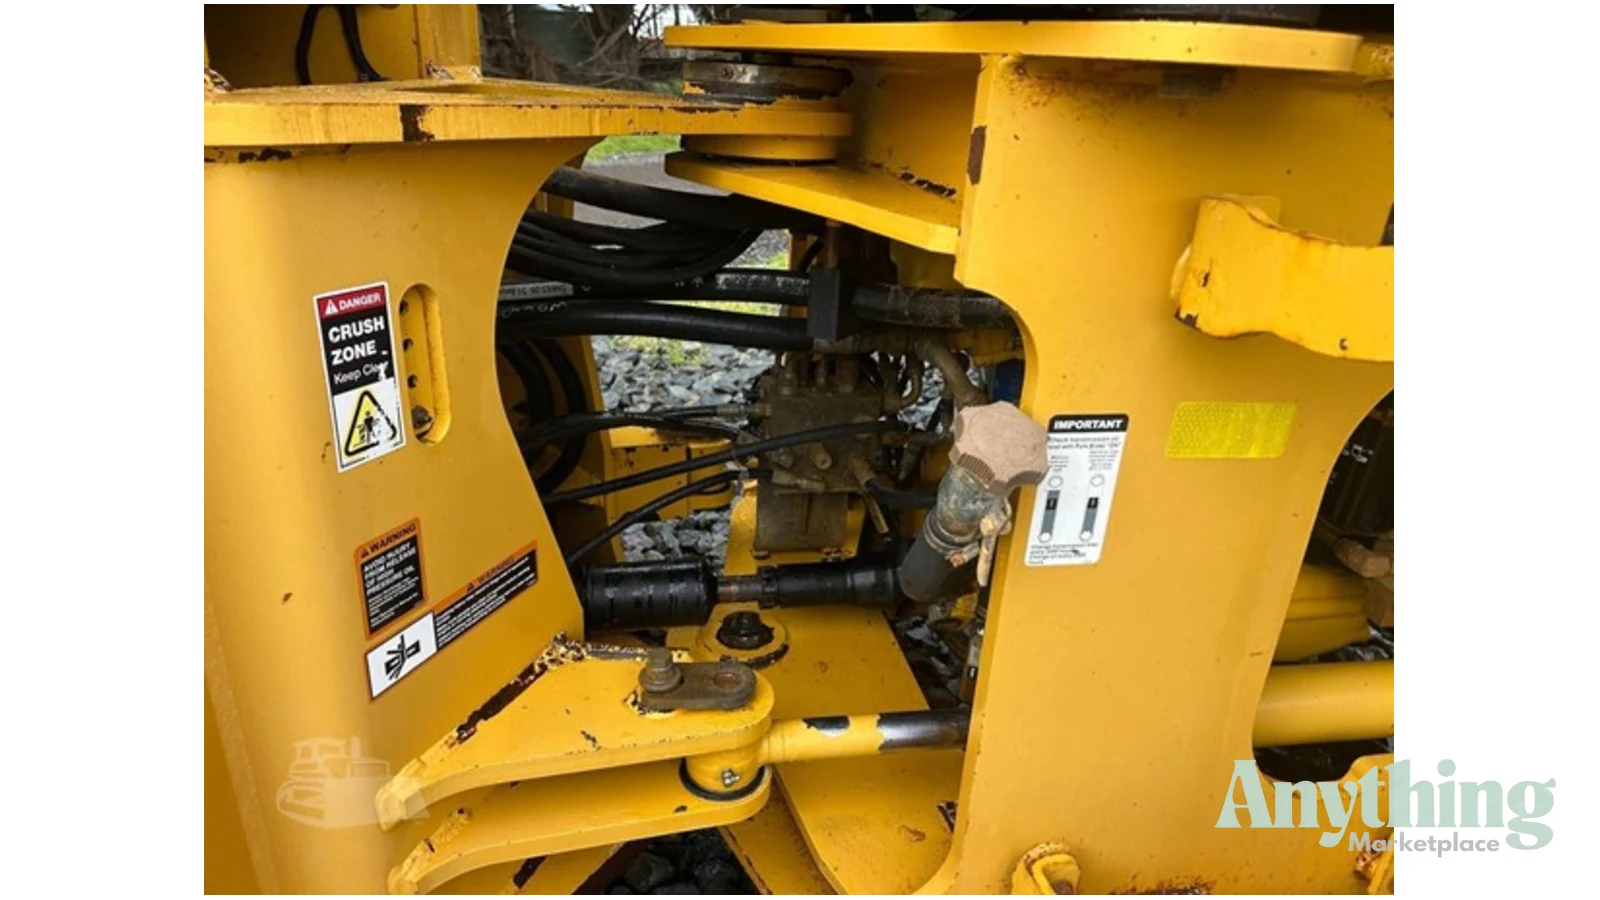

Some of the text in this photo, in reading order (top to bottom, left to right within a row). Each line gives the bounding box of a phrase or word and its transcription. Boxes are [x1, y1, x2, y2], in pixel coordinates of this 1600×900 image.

[339, 292, 381, 310] DANGER
[328, 316, 385, 343] CRUSH
[331, 341, 377, 366] ZONE
[333, 369, 361, 384] Keep
[1054, 419, 1123, 430] IMPORTANT
[370, 523, 416, 553] WARNING
